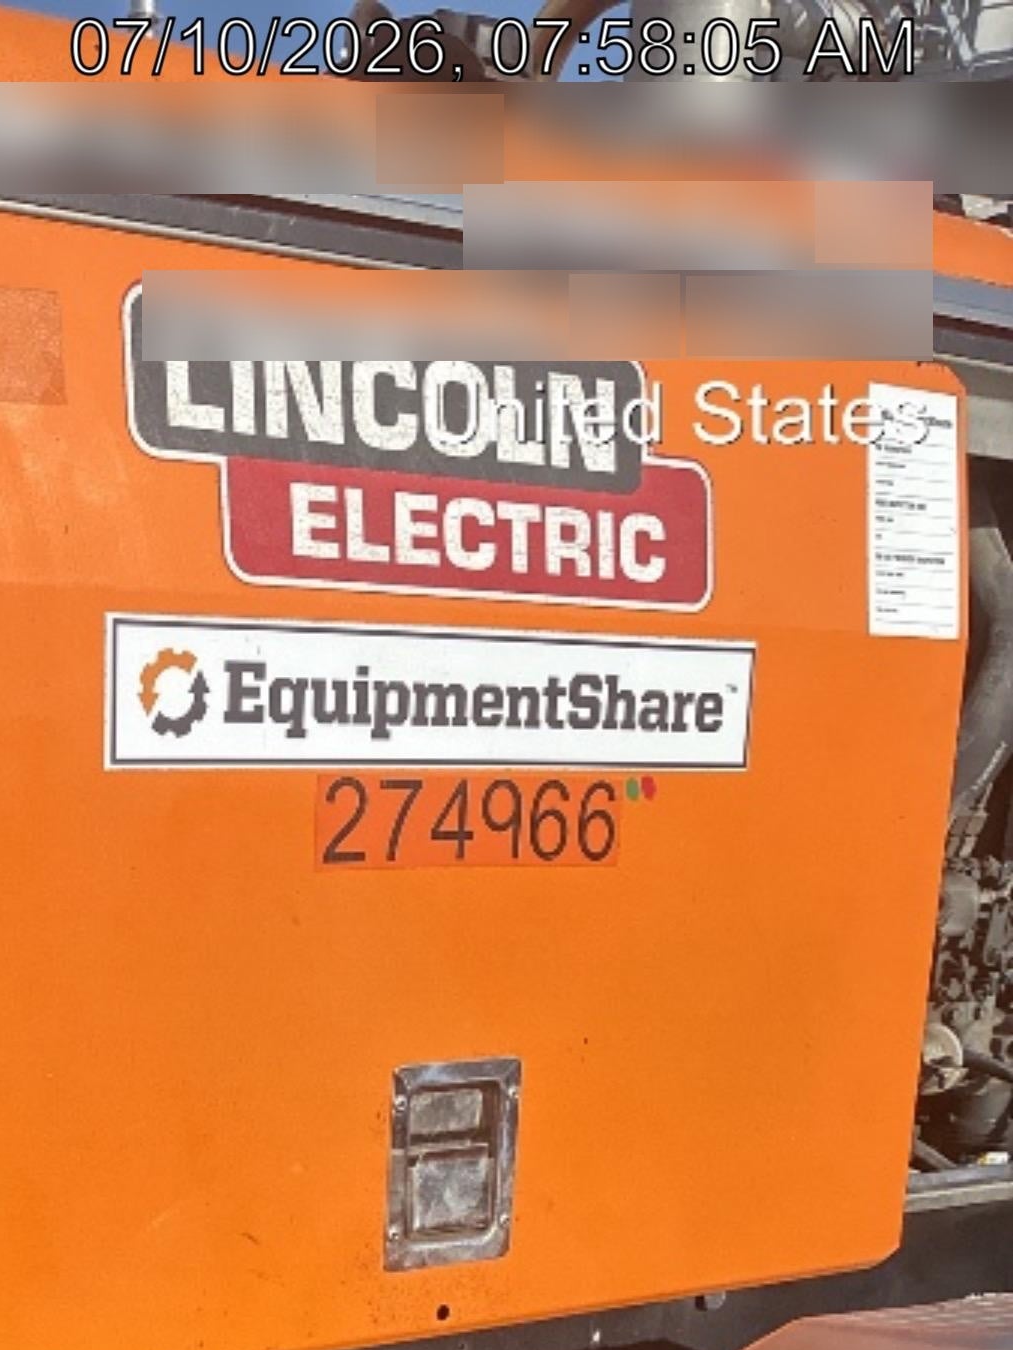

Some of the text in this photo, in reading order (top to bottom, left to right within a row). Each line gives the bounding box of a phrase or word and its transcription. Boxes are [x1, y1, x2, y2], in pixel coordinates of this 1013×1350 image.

[164, 360, 618, 473] LINCOLN
[289, 481, 667, 584] ELECTRIC
[223, 660, 725, 739] EquipmentShare
[322, 776, 616, 864] 274966
